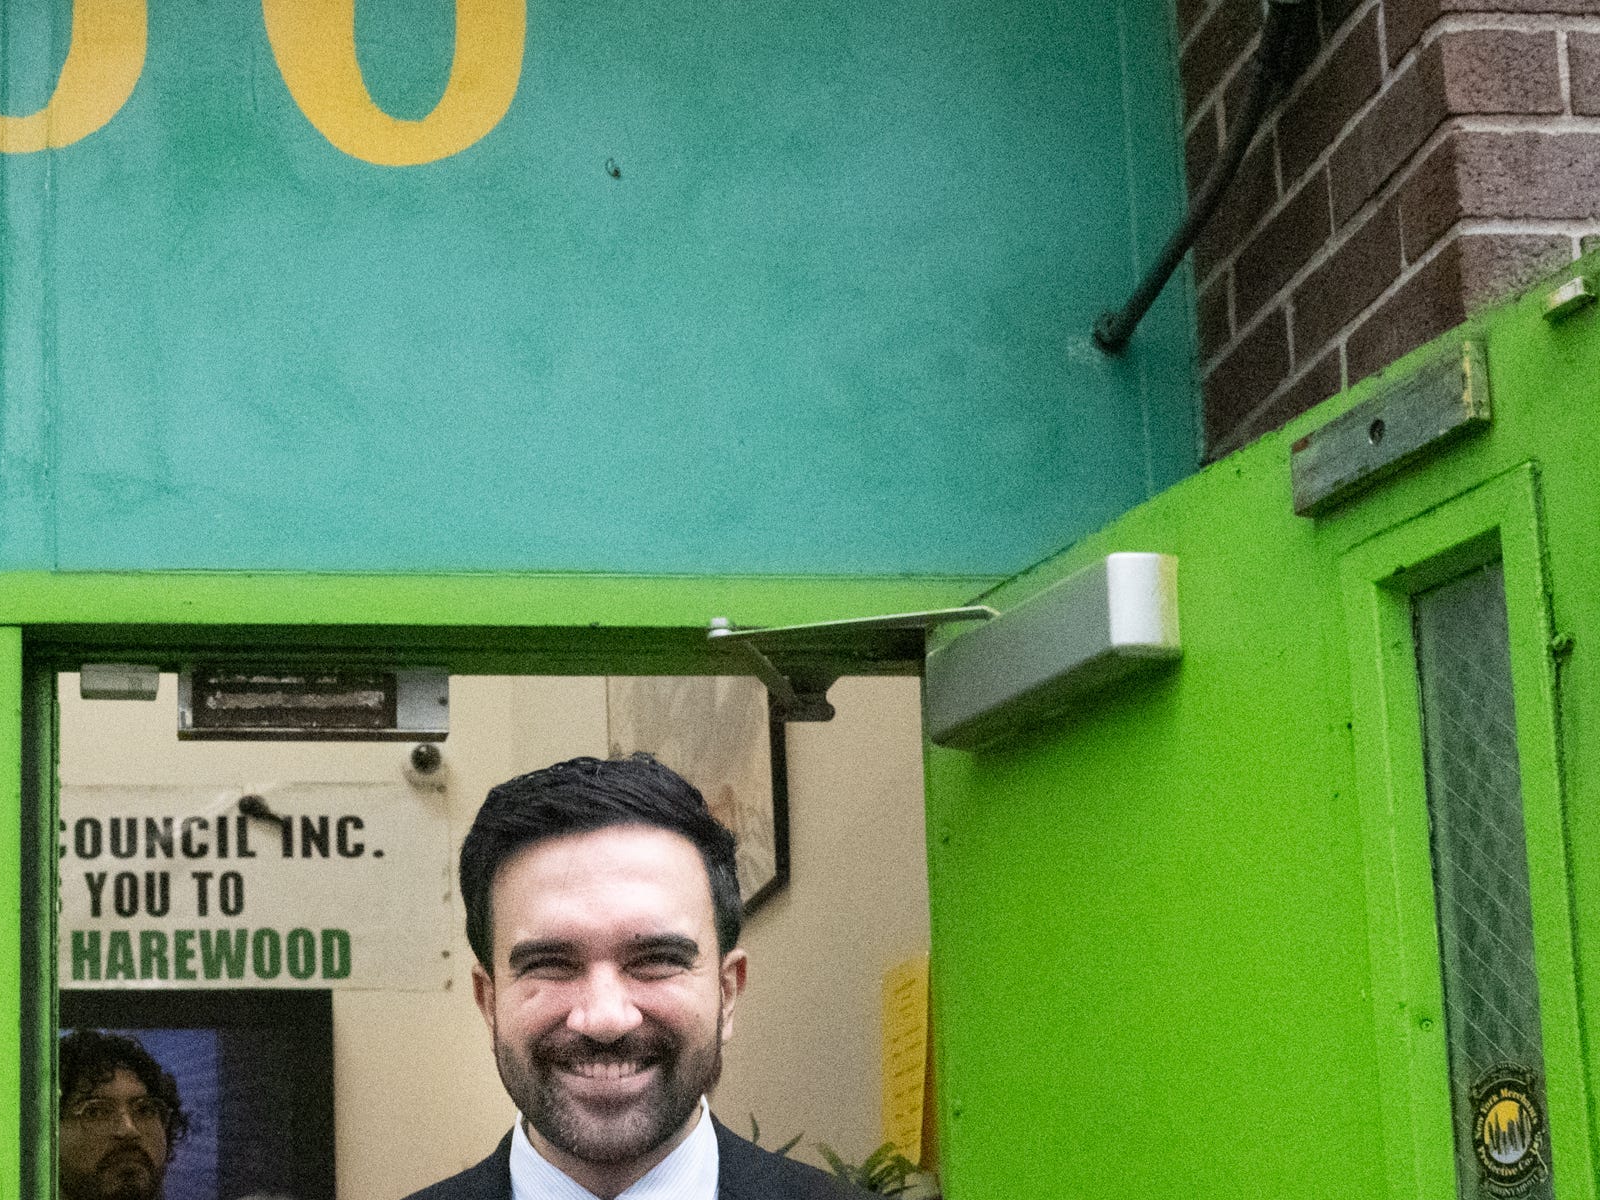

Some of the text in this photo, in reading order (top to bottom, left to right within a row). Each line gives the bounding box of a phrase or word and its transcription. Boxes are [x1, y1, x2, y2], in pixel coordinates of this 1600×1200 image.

[59, 814, 385, 860] OUNCIL INC.
[84, 870, 171, 918] YOU
[191, 870, 245, 918] TO
[71, 928, 353, 981] HAREWOOD
